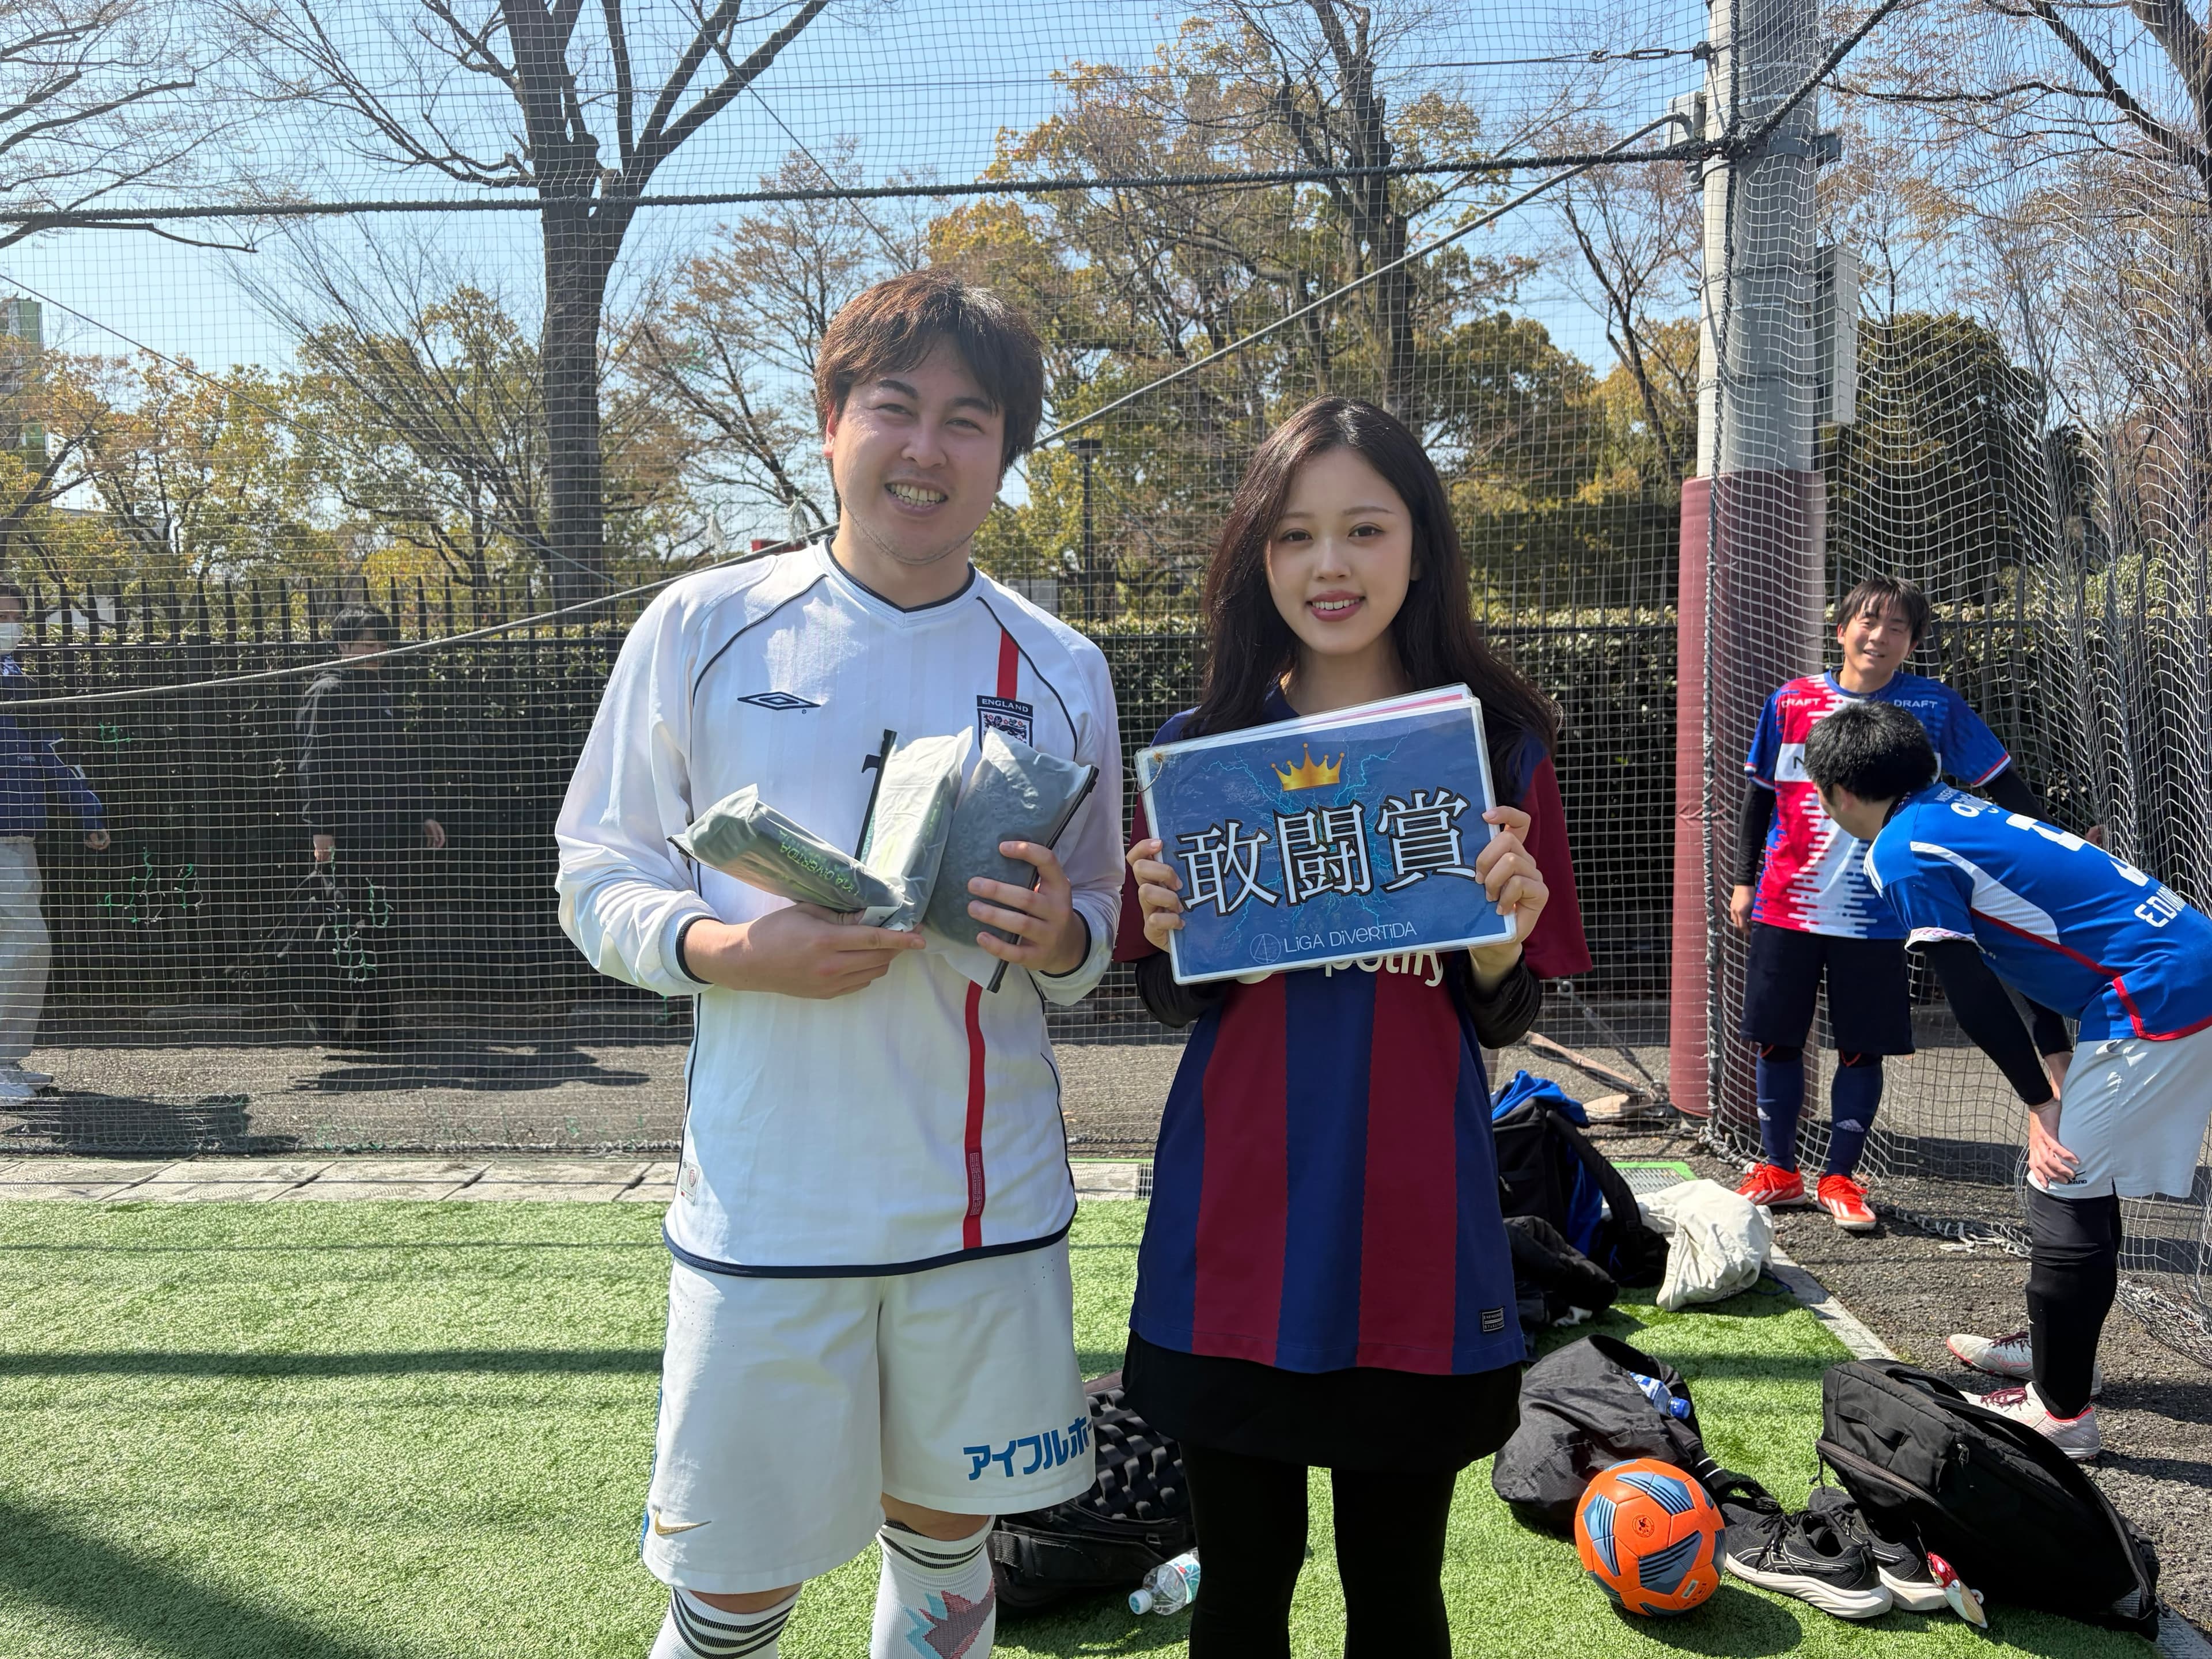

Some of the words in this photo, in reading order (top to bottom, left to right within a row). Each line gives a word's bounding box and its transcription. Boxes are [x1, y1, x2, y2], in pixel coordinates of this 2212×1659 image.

[982, 698, 1029, 713] ENGLAND
[1781, 698, 1821, 709] DRAFT
[1893, 699, 1938, 709] DRAFT
[1175, 788, 1476, 916] 敢闘賞
